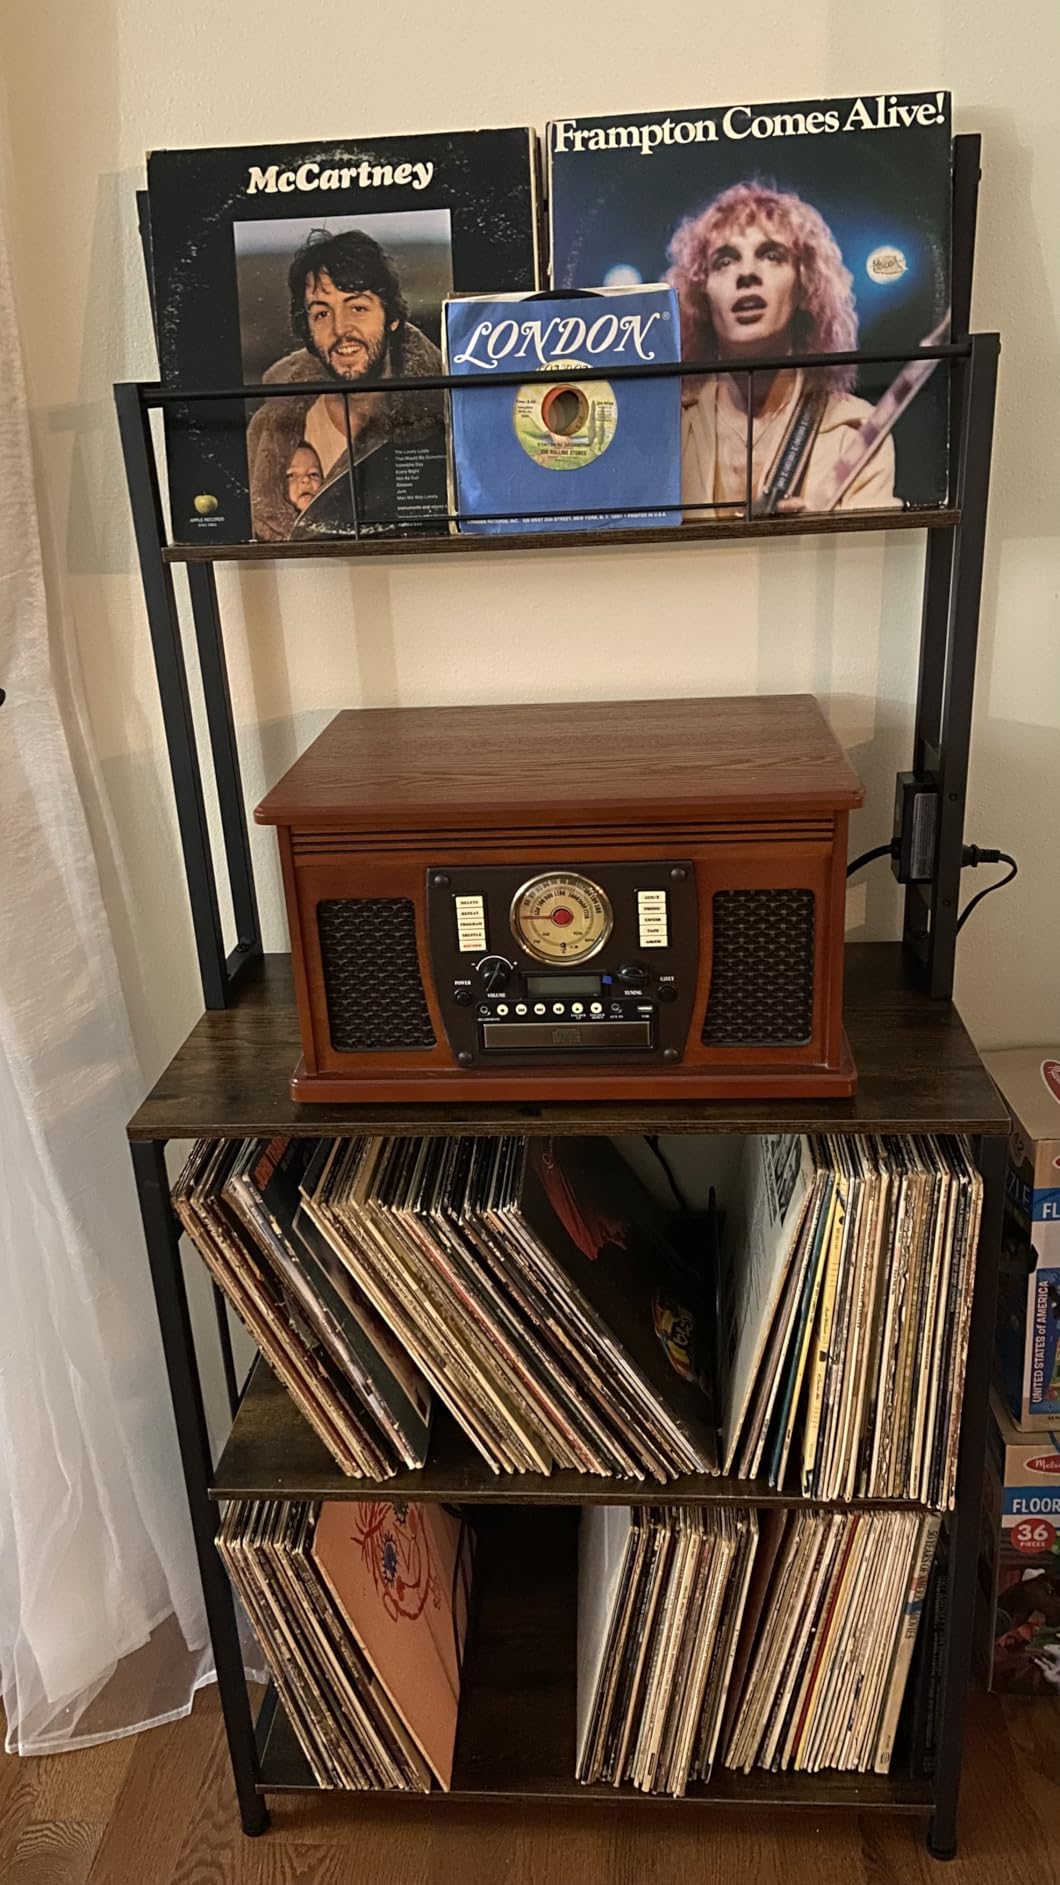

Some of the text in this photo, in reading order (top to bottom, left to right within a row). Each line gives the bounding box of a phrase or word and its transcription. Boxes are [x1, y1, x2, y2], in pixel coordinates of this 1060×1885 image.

[554, 92, 947, 155] Frampton Comes Alive!
[246, 161, 434, 195] McCartney
[454, 311, 660, 368] LONDON
[1032, 1281, 1049, 1403] UNITED STATES of AMERICA
[1012, 1498, 1060, 1514] FLOOR
[1017, 1524, 1048, 1541] 36
[922, 1539, 936, 1564] YEARS
